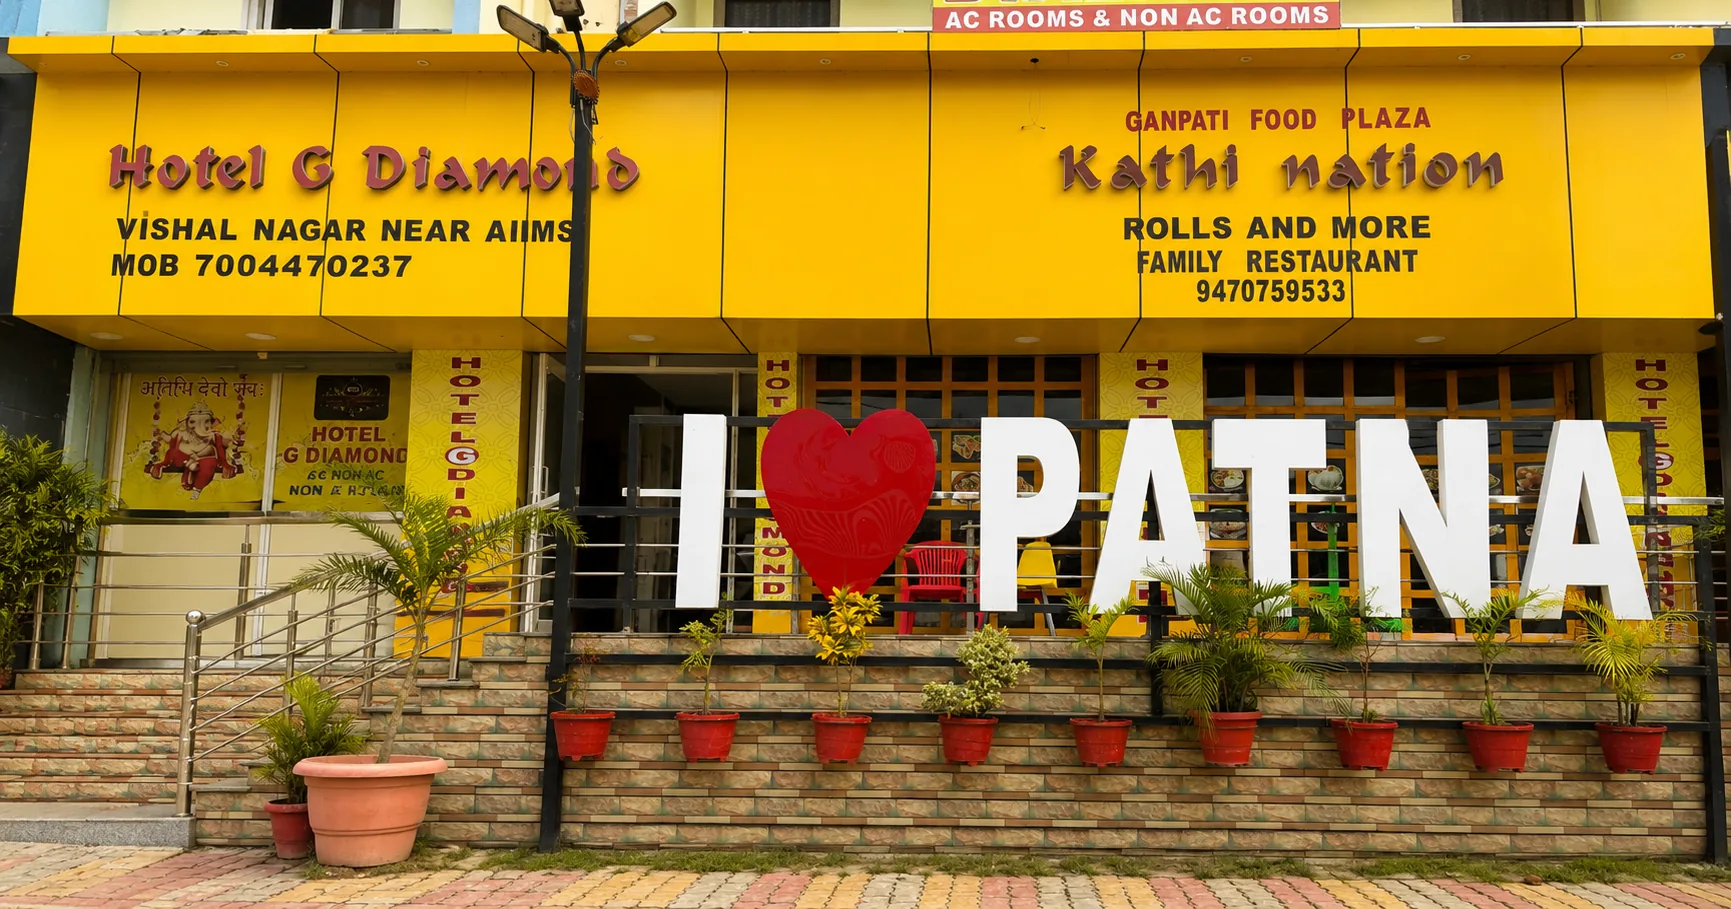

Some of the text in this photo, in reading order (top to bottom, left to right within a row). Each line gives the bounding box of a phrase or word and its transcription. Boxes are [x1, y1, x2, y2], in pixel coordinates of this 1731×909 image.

[945, 6, 1329, 29] AC ROOMS & NON AC ROOMS
[1125, 107, 1431, 132] GANPATI FOOD PLAZA
[109, 144, 266, 190] Hotel
[292, 145, 334, 190] G
[1059, 142, 1504, 190] Kathi nation
[253, 218, 366, 242] NAGAR
[381, 219, 470, 242] NEAR
[485, 219, 573, 243] AIIMS
[1123, 215, 1431, 241] ROLLS AND MORE
[111, 253, 412, 278] MOB 7004470237
[1137, 249, 1418, 274] FAMILY RESTAURANT
[1196, 278, 1345, 303] 9470759533
[449, 356, 481, 444] HOTEL
[765, 359, 791, 430] HOT
[1134, 358, 1169, 419] HOT
[311, 426, 386, 442] HOTEL
[283, 447, 299, 464] G
[675, 413, 728, 608] I
[979, 416, 1654, 622] PATNA
